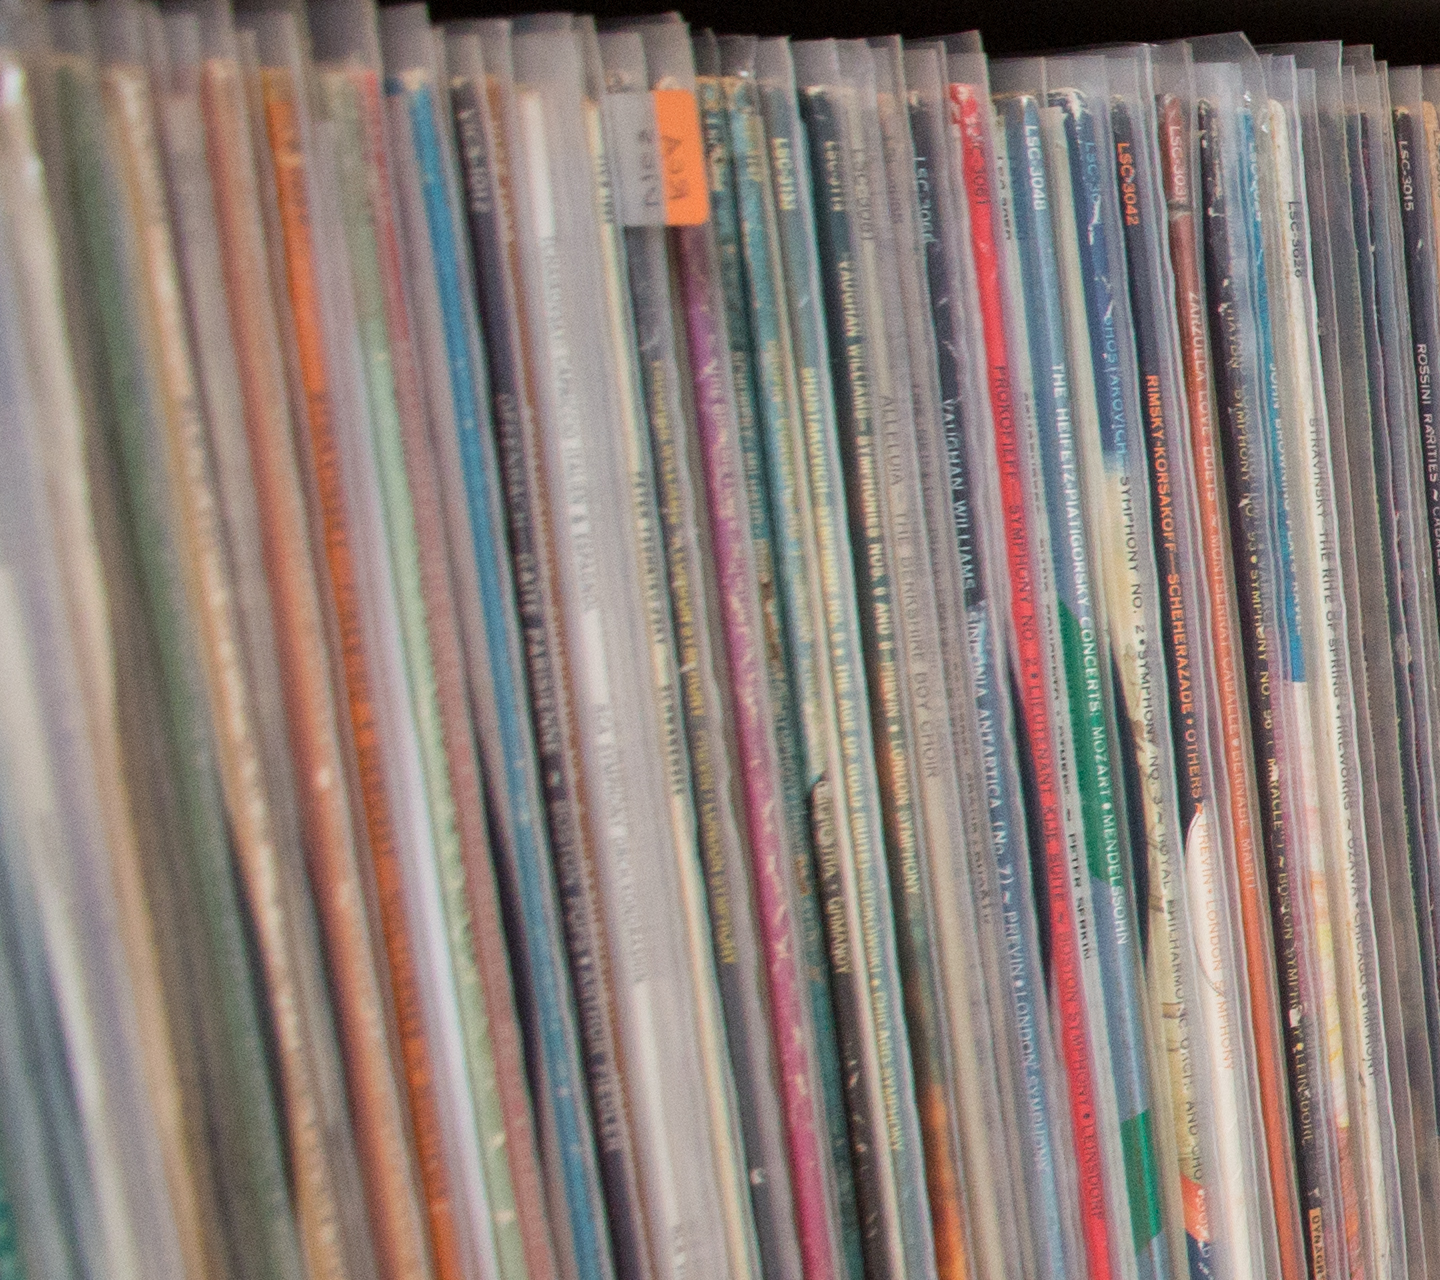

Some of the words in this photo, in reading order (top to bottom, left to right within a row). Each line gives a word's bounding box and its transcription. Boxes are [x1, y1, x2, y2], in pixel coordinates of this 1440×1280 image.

[1116, 141, 1138, 226] LSC-3042
[1398, 140, 1414, 211] LSC-3015
[1416, 343, 1432, 404] ROSSINI
[1197, 390, 1211, 435] LOVE
[1422, 412, 1439, 482] RARITIES
[1202, 445, 1217, 501] DUETS
[1023, 124, 1045, 211] LSC-3048
[1051, 364, 1066, 397] THE
[1079, 616, 1102, 716] CONCERTS:
[1091, 726, 1111, 796] MOZART
[1102, 813, 1128, 944] MENDELSSOHN
[1318, 531, 1333, 562] THE
[1209, 534, 1232, 646] MONTSERRAT
[1321, 567, 1337, 603] RITE
[1325, 609, 1339, 630] OF
[1327, 638, 1345, 698] SPRING
[940, 398, 963, 491] VAUGHAN
[1012, 992, 1037, 1067] LONDON
[1184, 729, 1205, 798] OTHERS
[1232, 389, 1251, 481] SYMPHONY
[1249, 569, 1268, 660] SYMPHONY
[1278, 873, 1295, 939] BOSTON
[1293, 1050, 1312, 1144] LEINSDORF
[1334, 715, 1355, 810] FIREWORKS
[1119, 475, 1139, 571] SYMPHONY
[1137, 651, 1156, 743] SYMPHONY
[1185, 1100, 1199, 1137] AND
[1195, 822, 1213, 885] PREVIN
[1204, 900, 1223, 971] LONDON
[1064, 1010, 1091, 1106] SYMPHONY
[1213, 979, 1234, 1070] SYMPHONY
